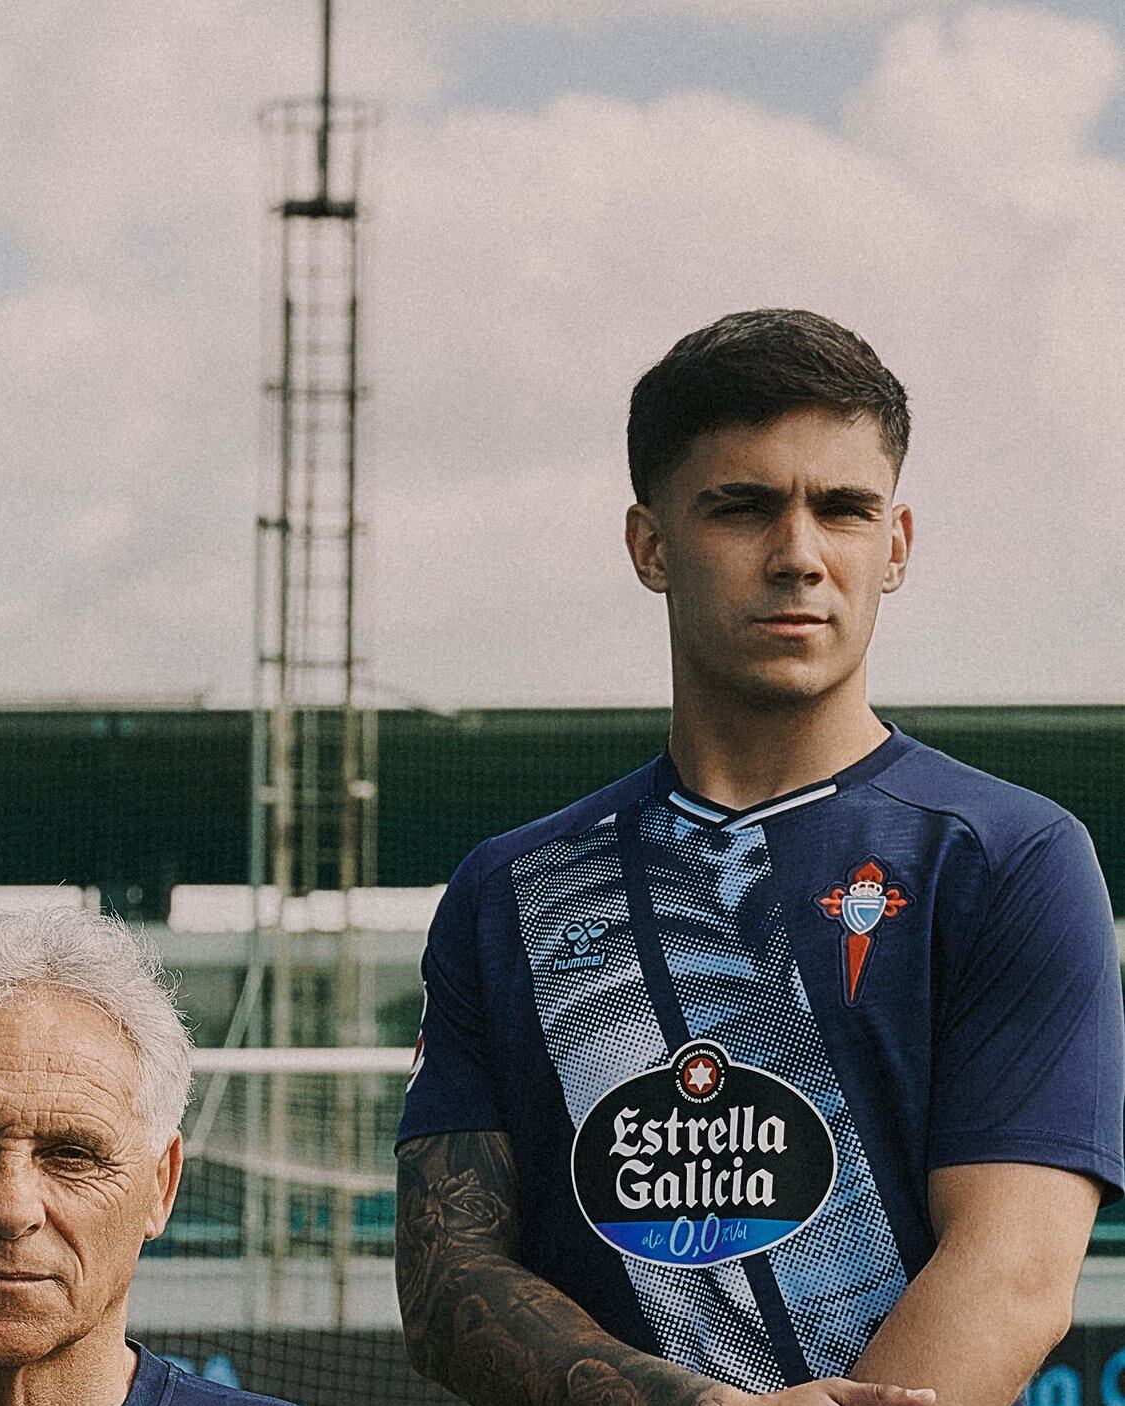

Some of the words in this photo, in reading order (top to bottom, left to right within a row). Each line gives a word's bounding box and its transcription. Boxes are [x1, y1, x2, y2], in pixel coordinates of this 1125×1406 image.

[552, 952, 606, 971] hummel
[609, 1105, 788, 1156] Estrella
[616, 1157, 776, 1209] Galicia
[641, 1229, 666, 1249] alc.
[669, 1212, 720, 1257] 0,0
